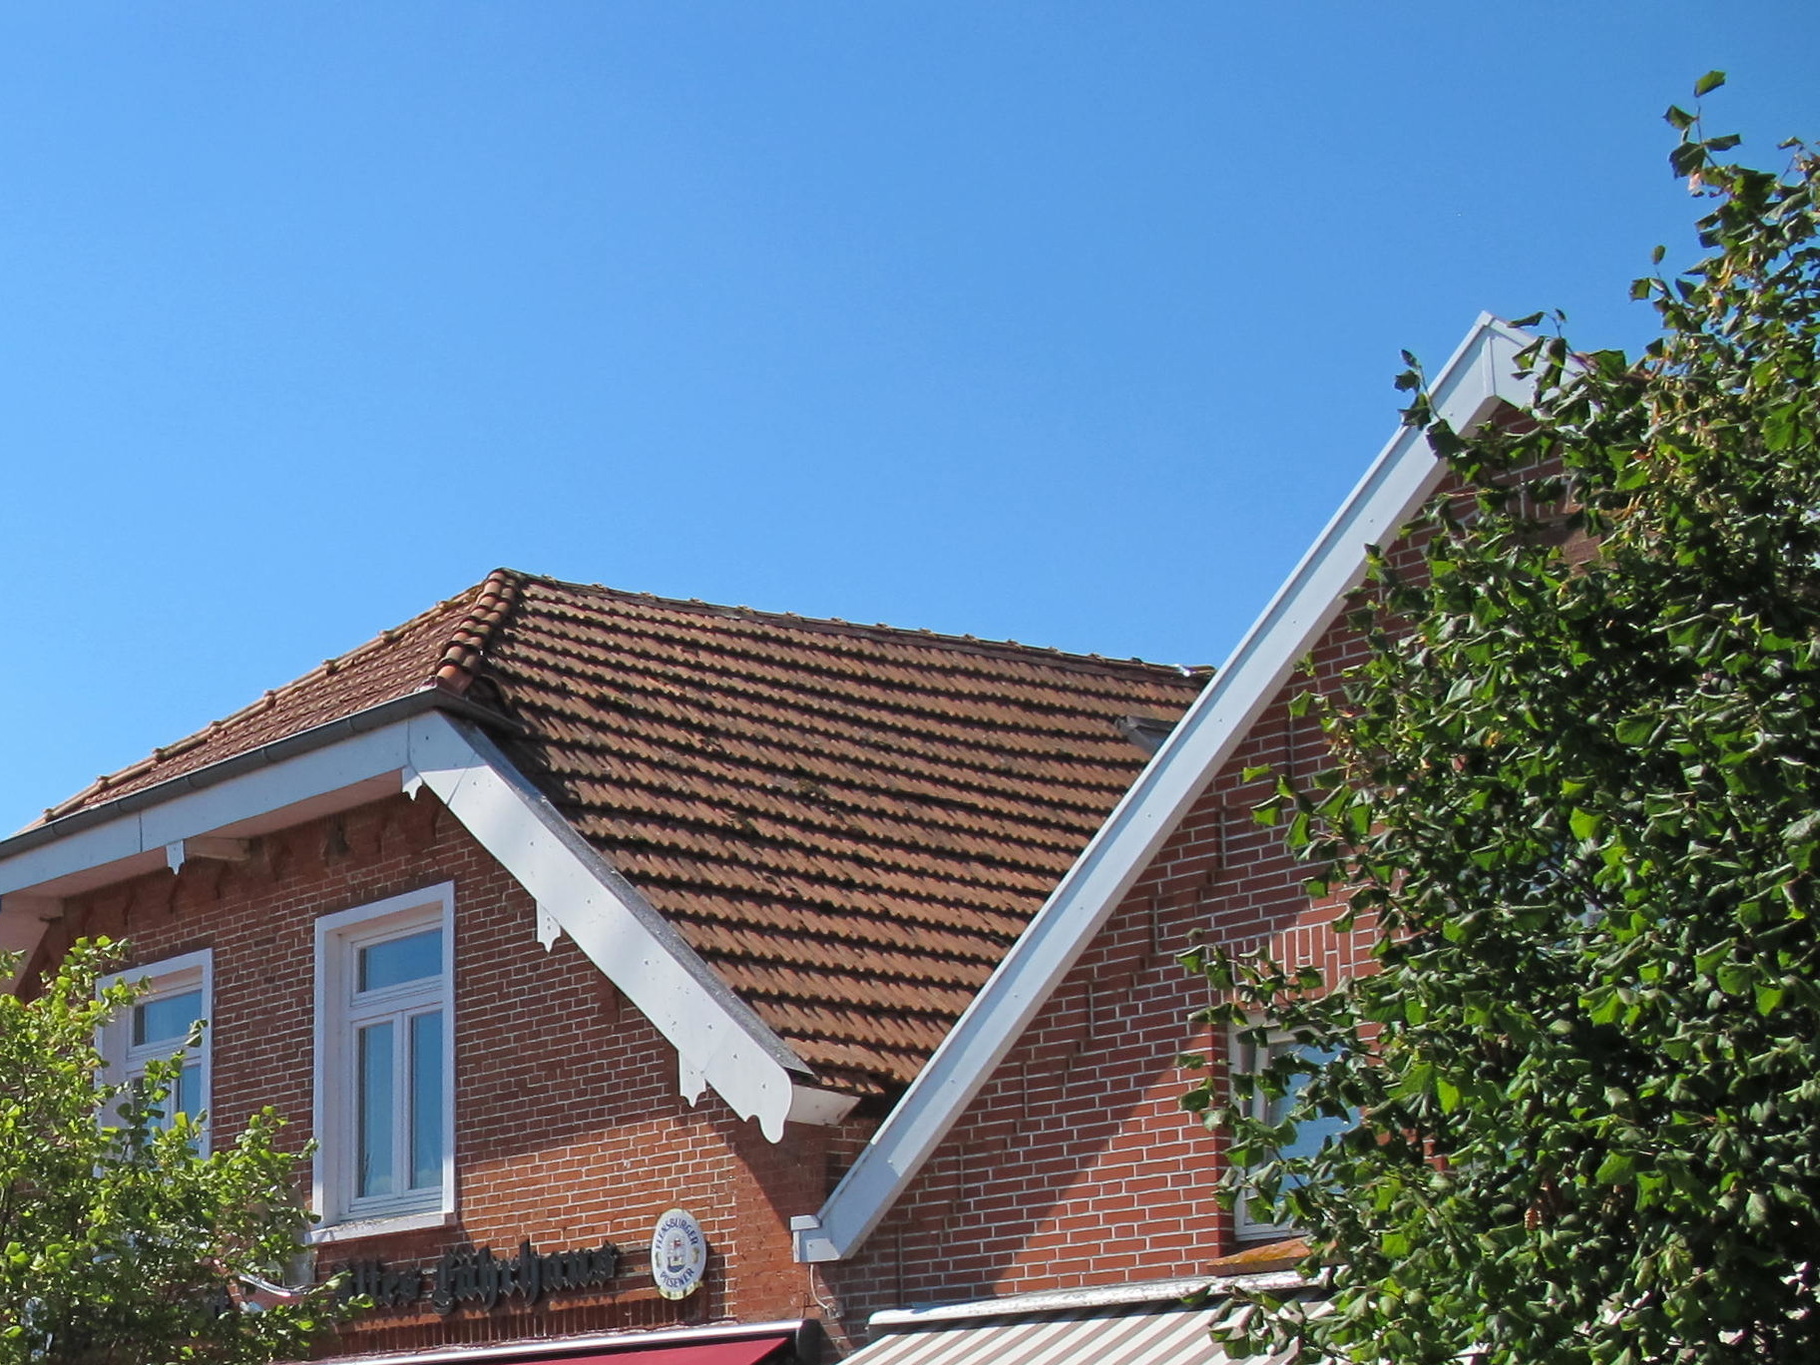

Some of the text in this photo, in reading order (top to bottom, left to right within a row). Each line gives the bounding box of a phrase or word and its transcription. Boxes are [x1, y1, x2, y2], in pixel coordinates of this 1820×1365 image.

[655, 1217, 700, 1249] FLENSBURGER
[431, 1239, 621, 1317] Fährhaus
[659, 1267, 695, 1288] PILSENER
